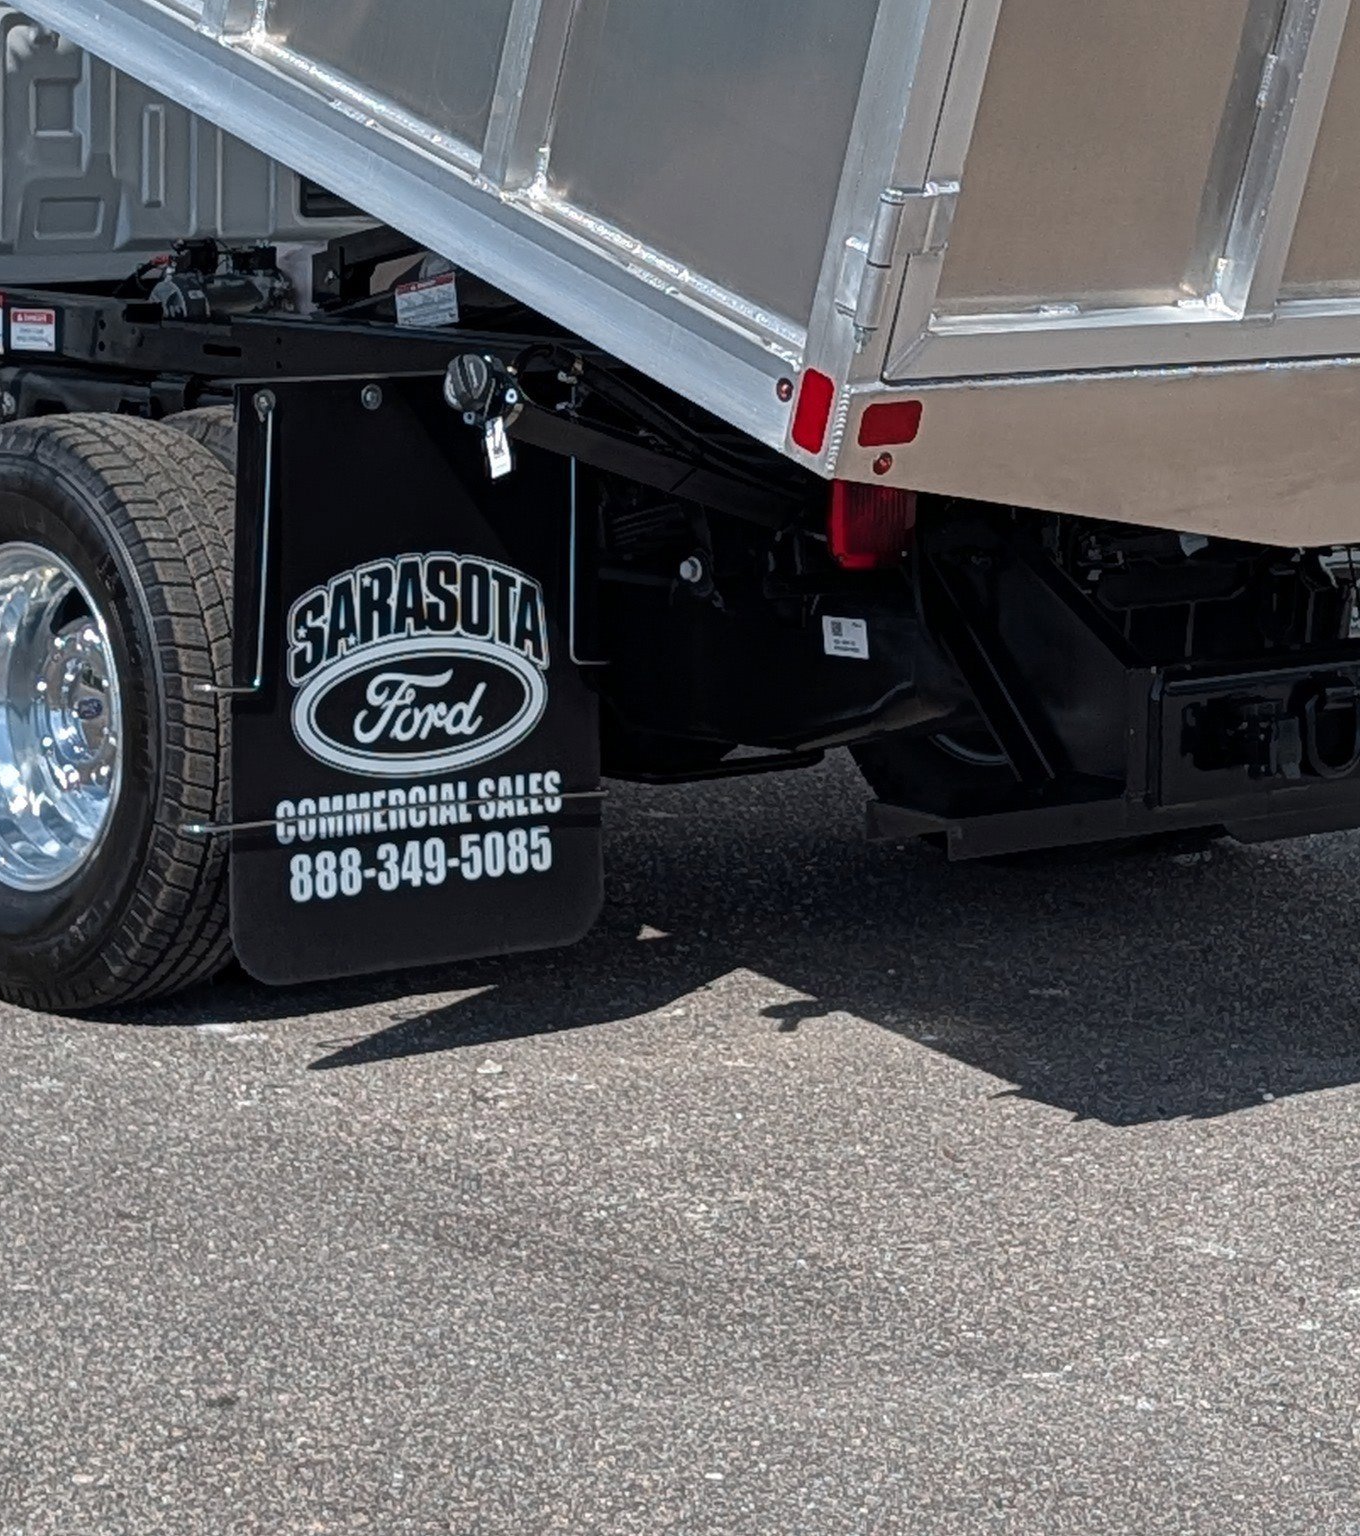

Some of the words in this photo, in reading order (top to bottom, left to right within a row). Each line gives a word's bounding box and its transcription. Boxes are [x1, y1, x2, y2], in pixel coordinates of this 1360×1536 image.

[288, 553, 549, 686] SARASOTA
[353, 668, 487, 743] Ford
[275, 781, 472, 844] COMMERCIAL
[478, 770, 562, 821] SALES
[290, 825, 553, 902] 888-349-5085
